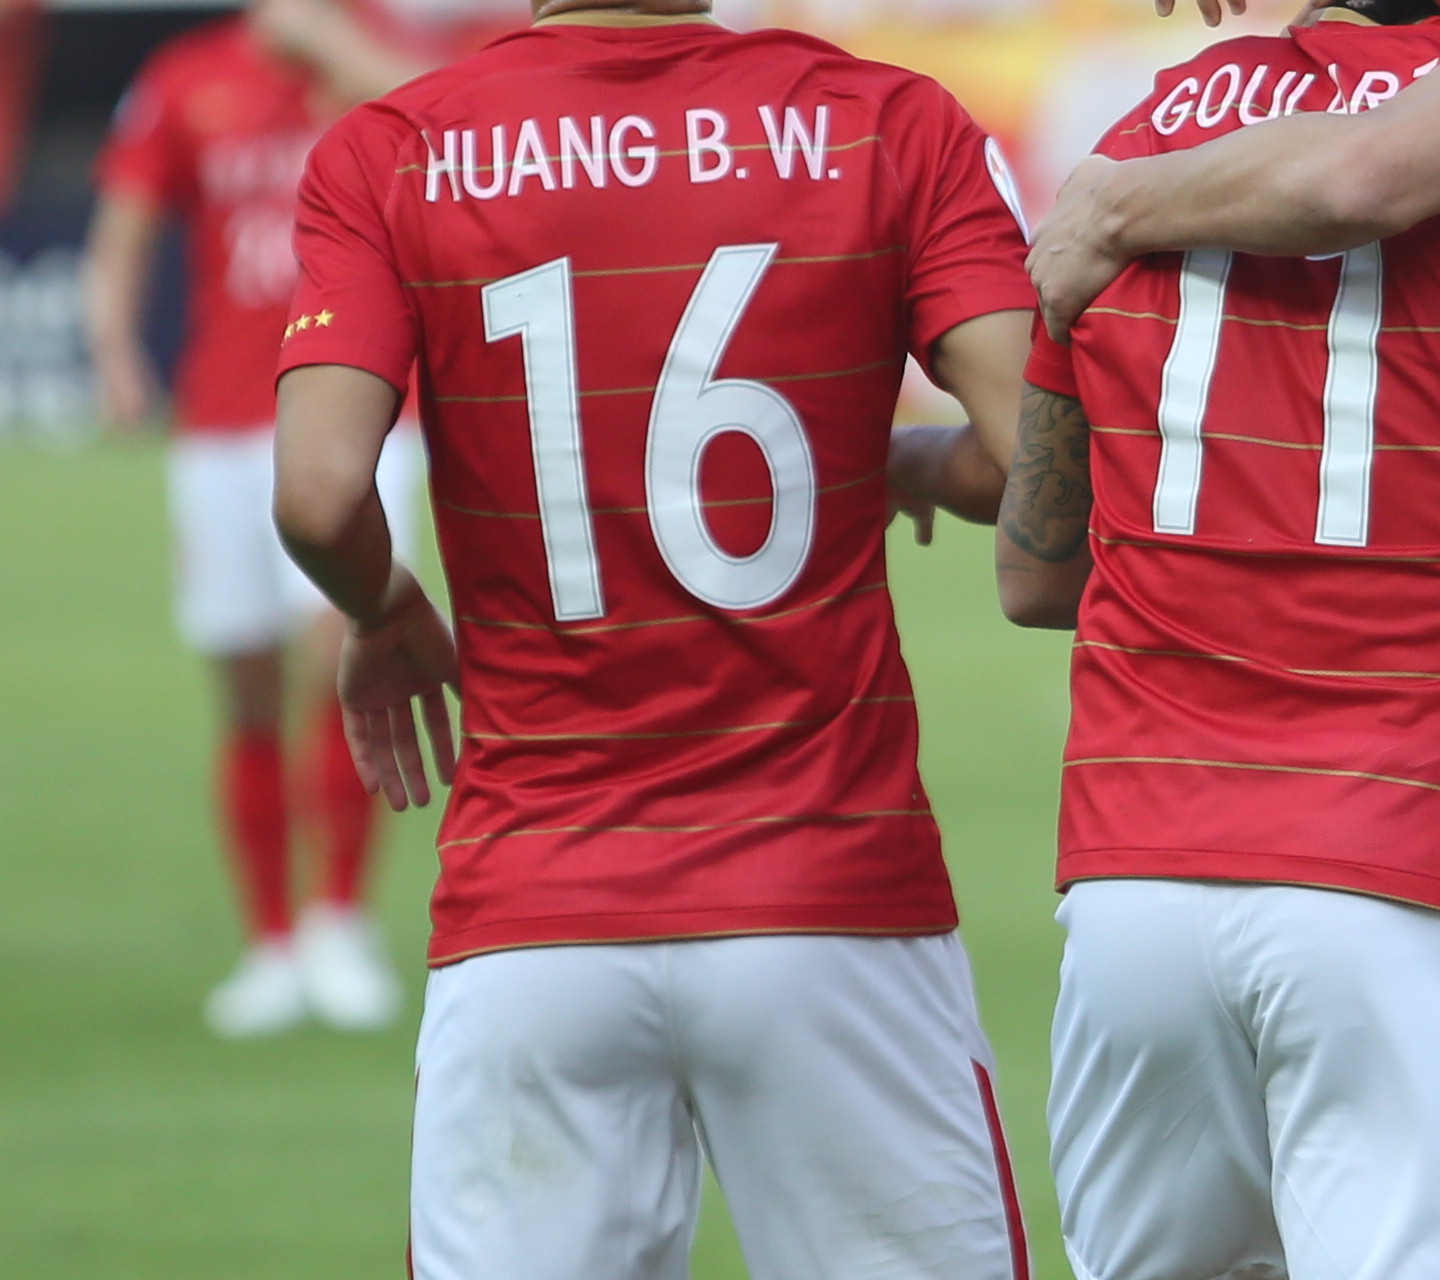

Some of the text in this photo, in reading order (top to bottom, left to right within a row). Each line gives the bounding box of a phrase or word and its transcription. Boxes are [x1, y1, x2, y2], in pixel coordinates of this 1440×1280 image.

[421, 105, 839, 202] HUANG B. W.
[482, 242, 816, 621] 16
